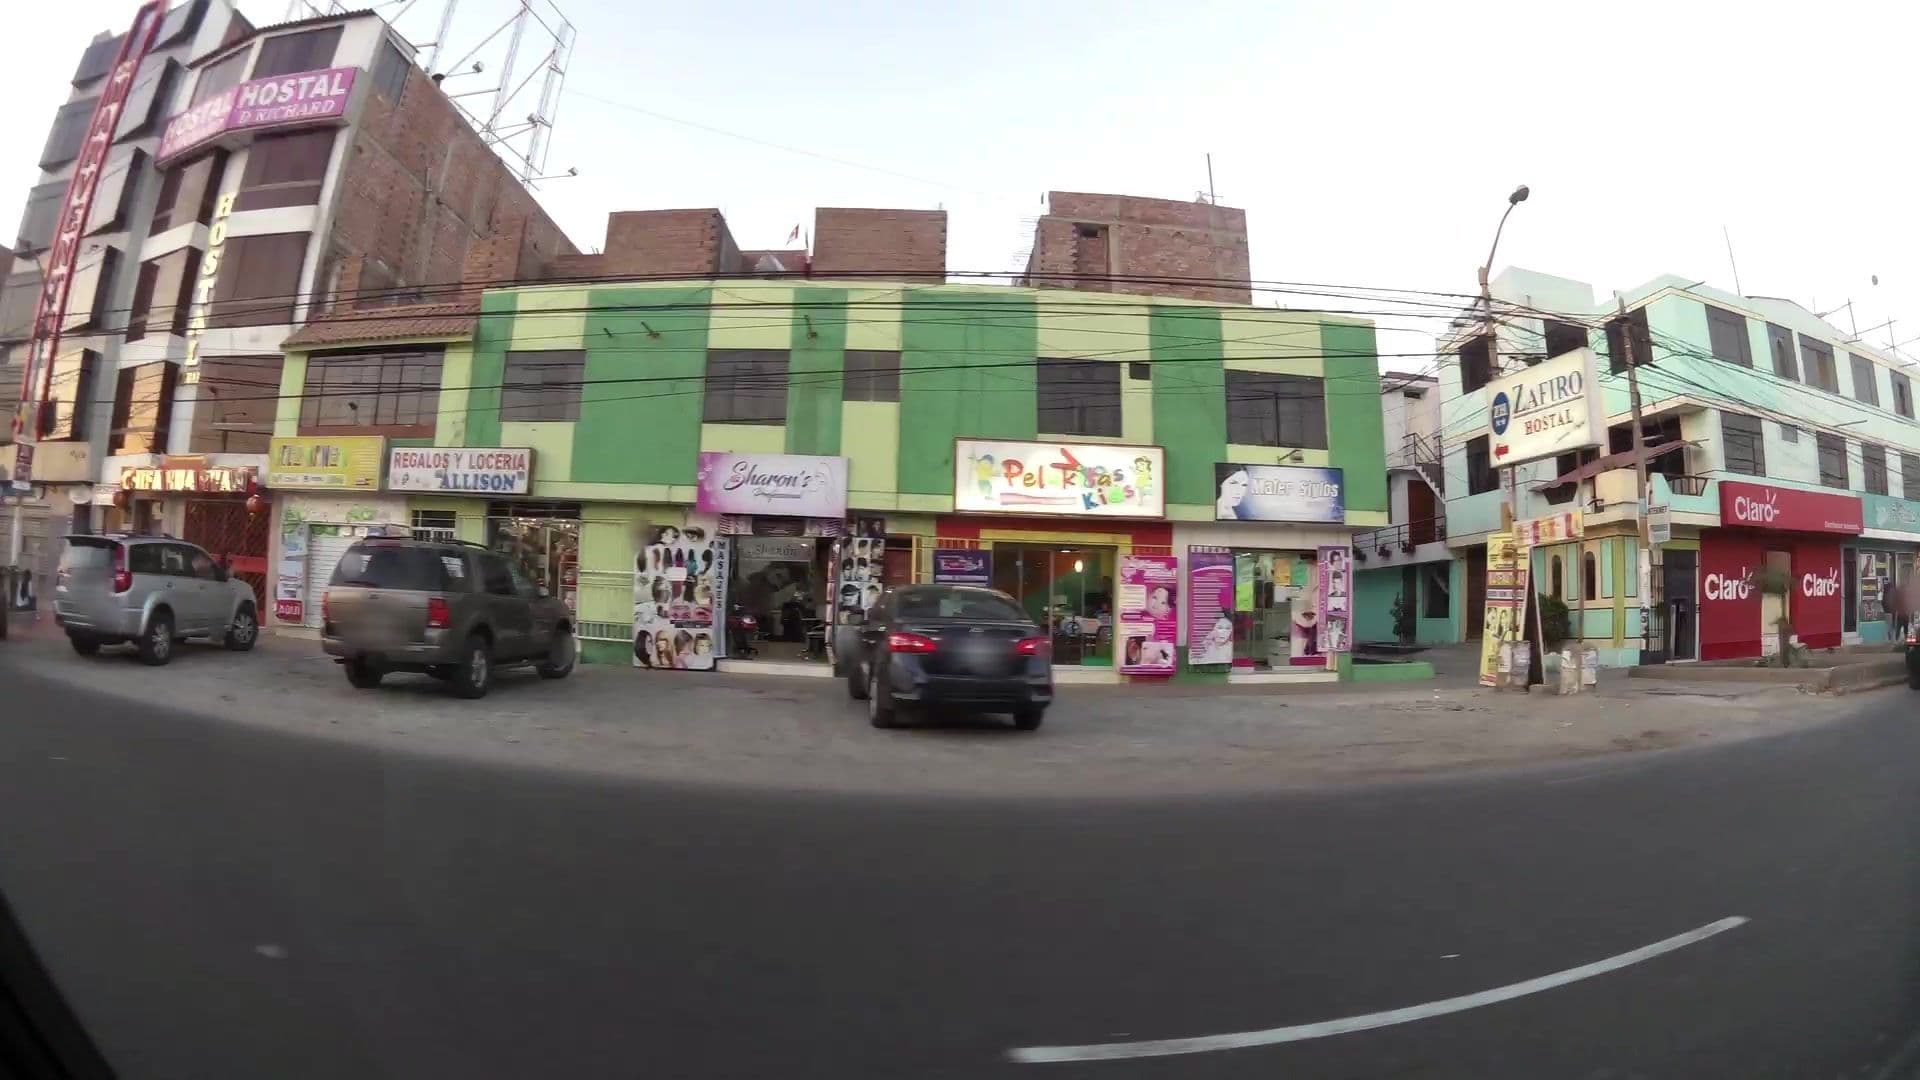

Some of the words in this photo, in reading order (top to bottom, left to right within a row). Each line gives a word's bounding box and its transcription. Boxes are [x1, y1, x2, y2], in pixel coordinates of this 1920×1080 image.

[238, 72, 346, 108] HOSTAL
[185, 192, 236, 366] HOSTAL
[1512, 371, 1582, 413] ZAFIRO
[1525, 409, 1572, 435] HOSTAL
[393, 452, 450, 468] REGALOS
[454, 452, 463, 469] Y
[468, 453, 526, 470] LOCERIA
[723, 460, 812, 491] Sharon's
[1735, 494, 1774, 522] Claro
[1704, 572, 1749, 600] Claro
[1802, 572, 1835, 597] Claro
